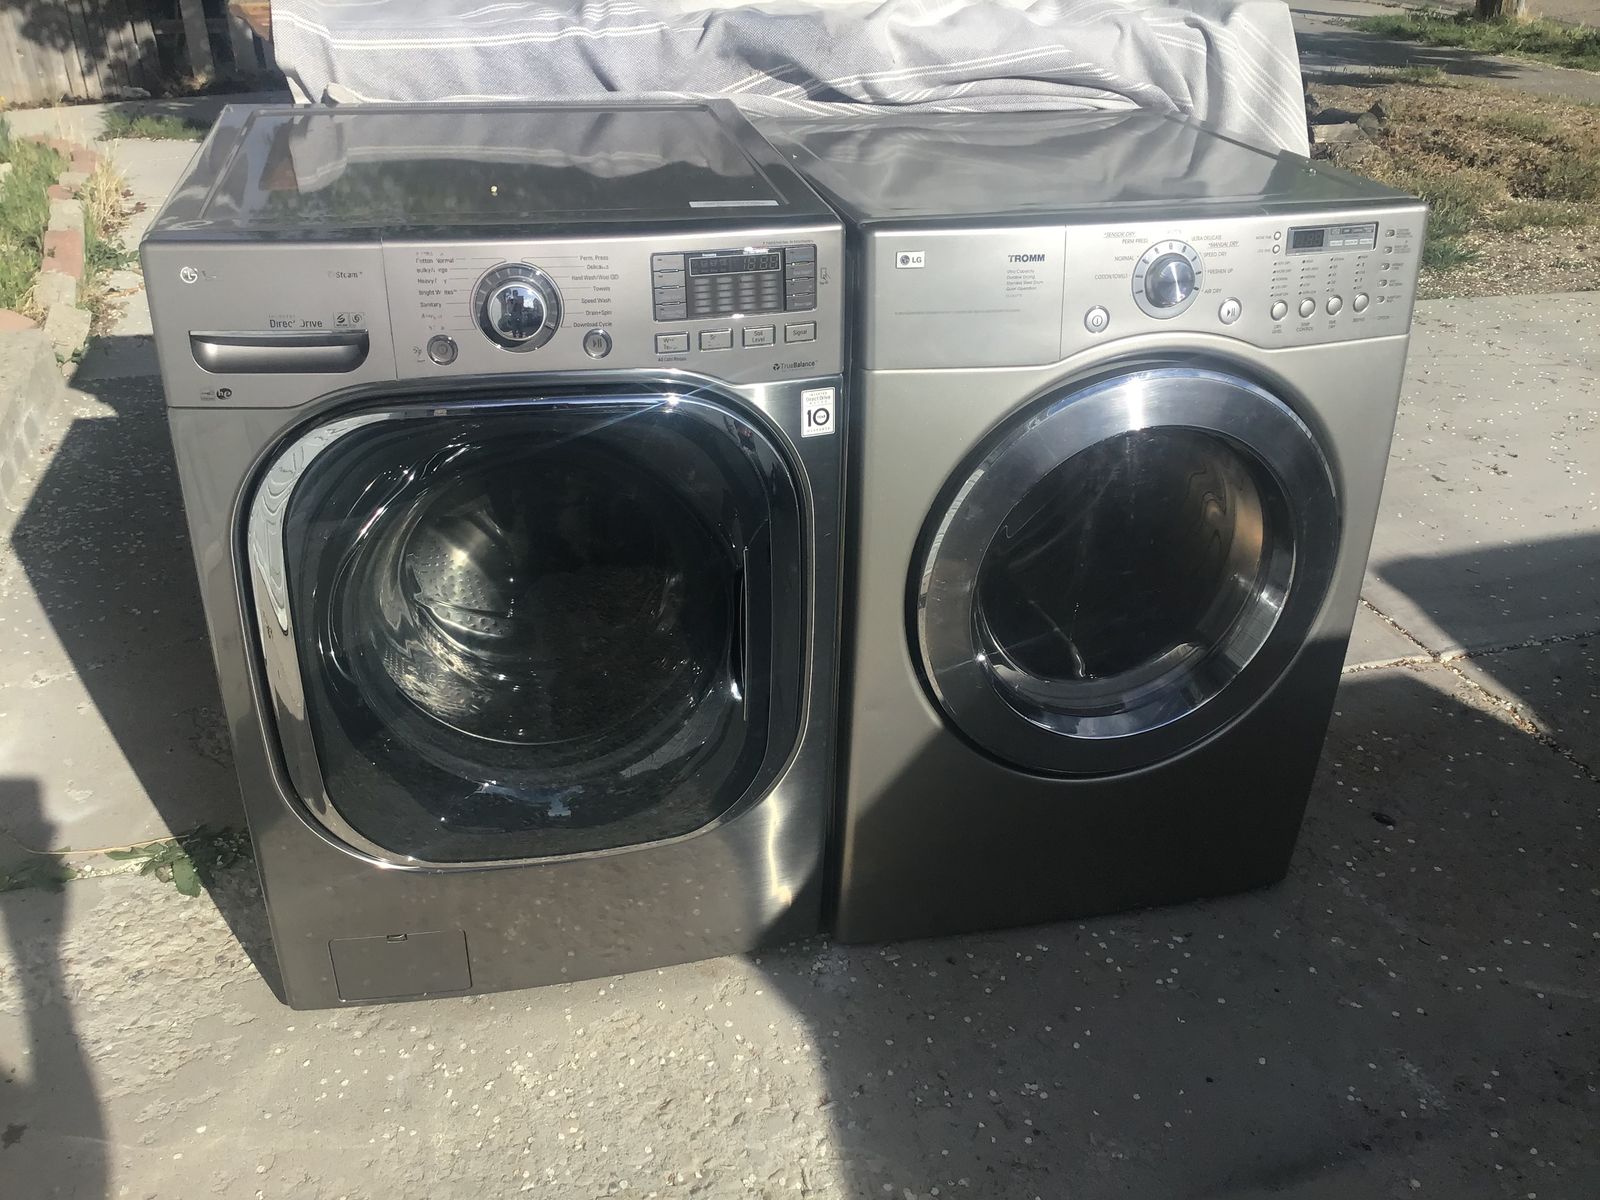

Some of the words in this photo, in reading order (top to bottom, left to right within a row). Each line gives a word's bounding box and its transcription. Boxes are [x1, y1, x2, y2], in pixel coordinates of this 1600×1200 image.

[1007, 253, 1045, 263] TROMM
[792, 329, 808, 337] Signal
[807, 407, 830, 427] 10
